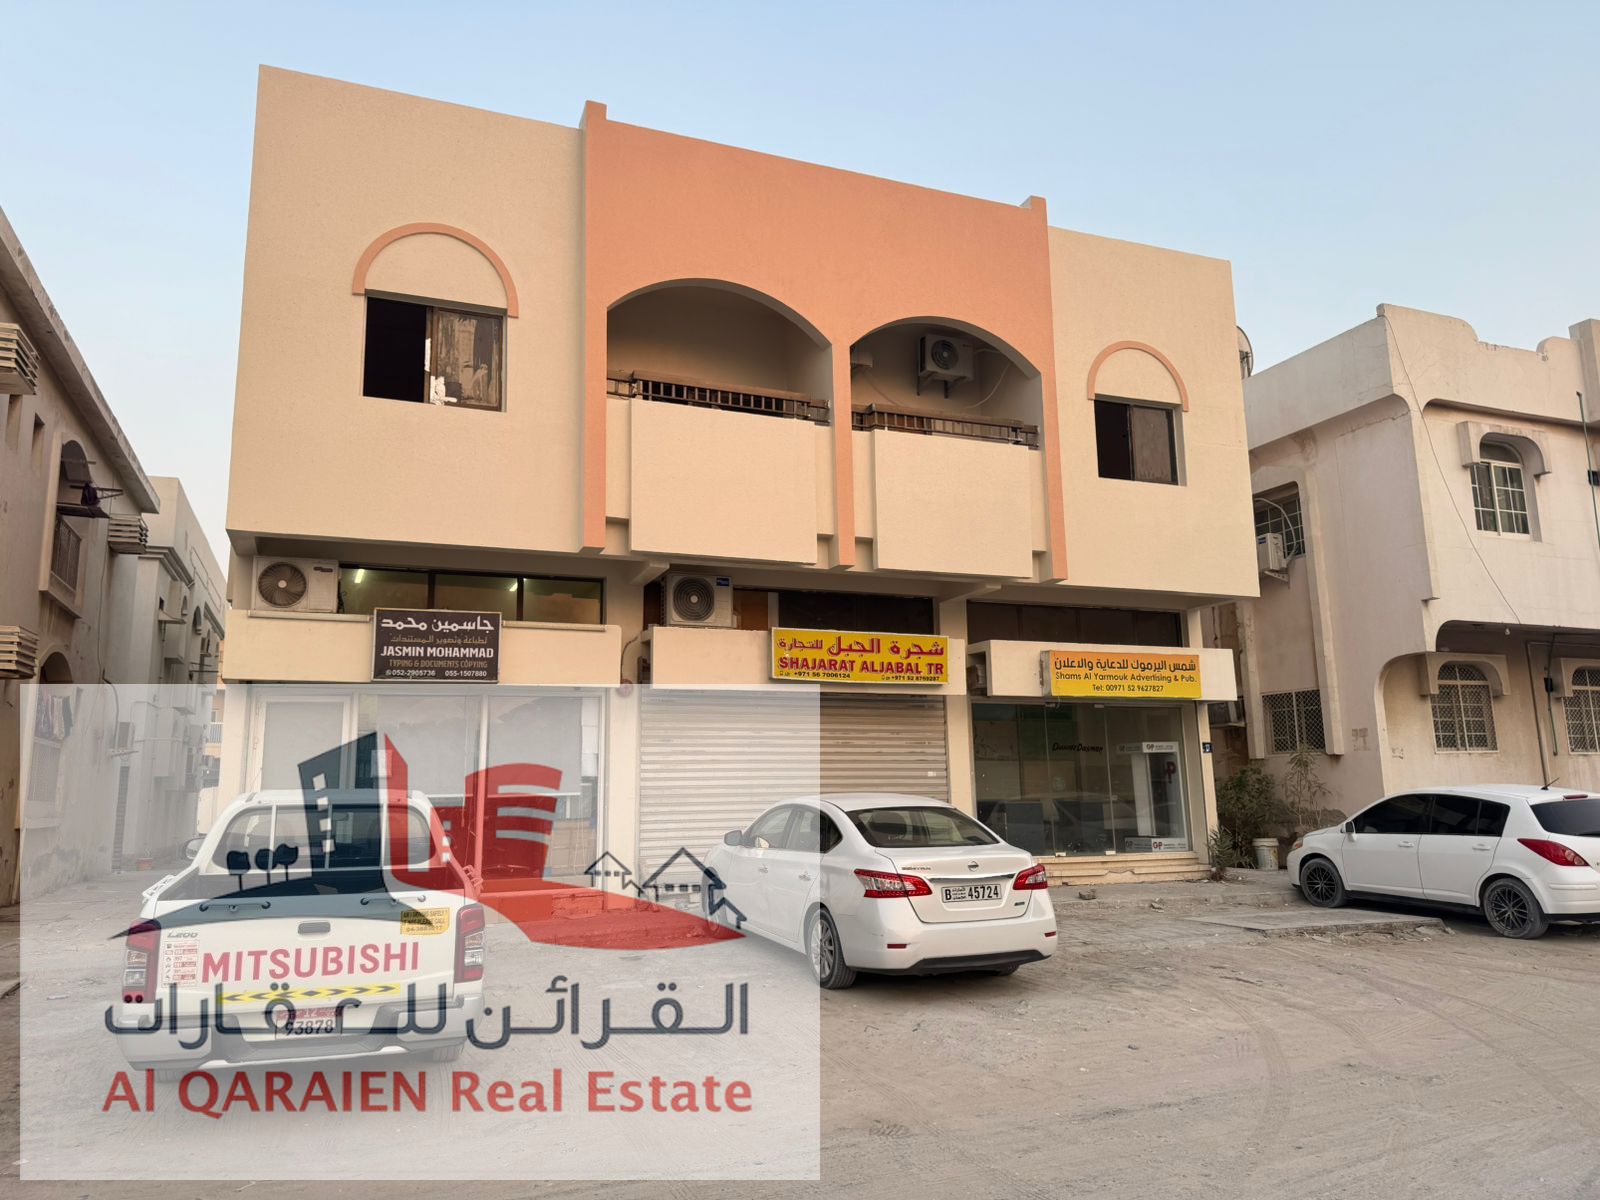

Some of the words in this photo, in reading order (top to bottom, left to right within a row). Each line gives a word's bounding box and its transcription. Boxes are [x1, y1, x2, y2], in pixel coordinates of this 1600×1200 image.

[381, 618, 428, 630] محمد
[432, 616, 494, 633] جاسمين
[463, 636, 488, 644] لطباعة
[777, 637, 823, 652] للتجارة
[827, 636, 881, 657] الجبل
[381, 646, 425, 657] JASMIN
[427, 647, 494, 658] MOHAMMAD
[889, 640, 944, 660] شجرة
[389, 659, 413, 668] TYPING
[414, 660, 420, 668] &
[420, 660, 459, 668] DOCUMENTS
[778, 656, 855, 672] SHAJARAT
[860, 660, 922, 674] ALJABAL
[925, 663, 944, 675] TR
[1096, 658, 1129, 671] للدعاية
[1130, 659, 1167, 673] اليرموك
[1168, 659, 1196, 673] شمس
[1055, 671, 1082, 680] Shams
[1083, 672, 1092, 680] Al
[1093, 672, 1129, 681] Yarmouk
[1130, 673, 1172, 684] Advertising
[1173, 674, 1179, 682] &
[1180, 674, 1197, 683] Pub.
[1105, 684, 1125, 692] 00971
[1127, 684, 1136, 692] 52
[944, 889, 952, 901] B
[967, 885, 999, 899] 45724
[201, 942, 419, 984] MITSUBISHI
[285, 1019, 334, 1036] 93878
